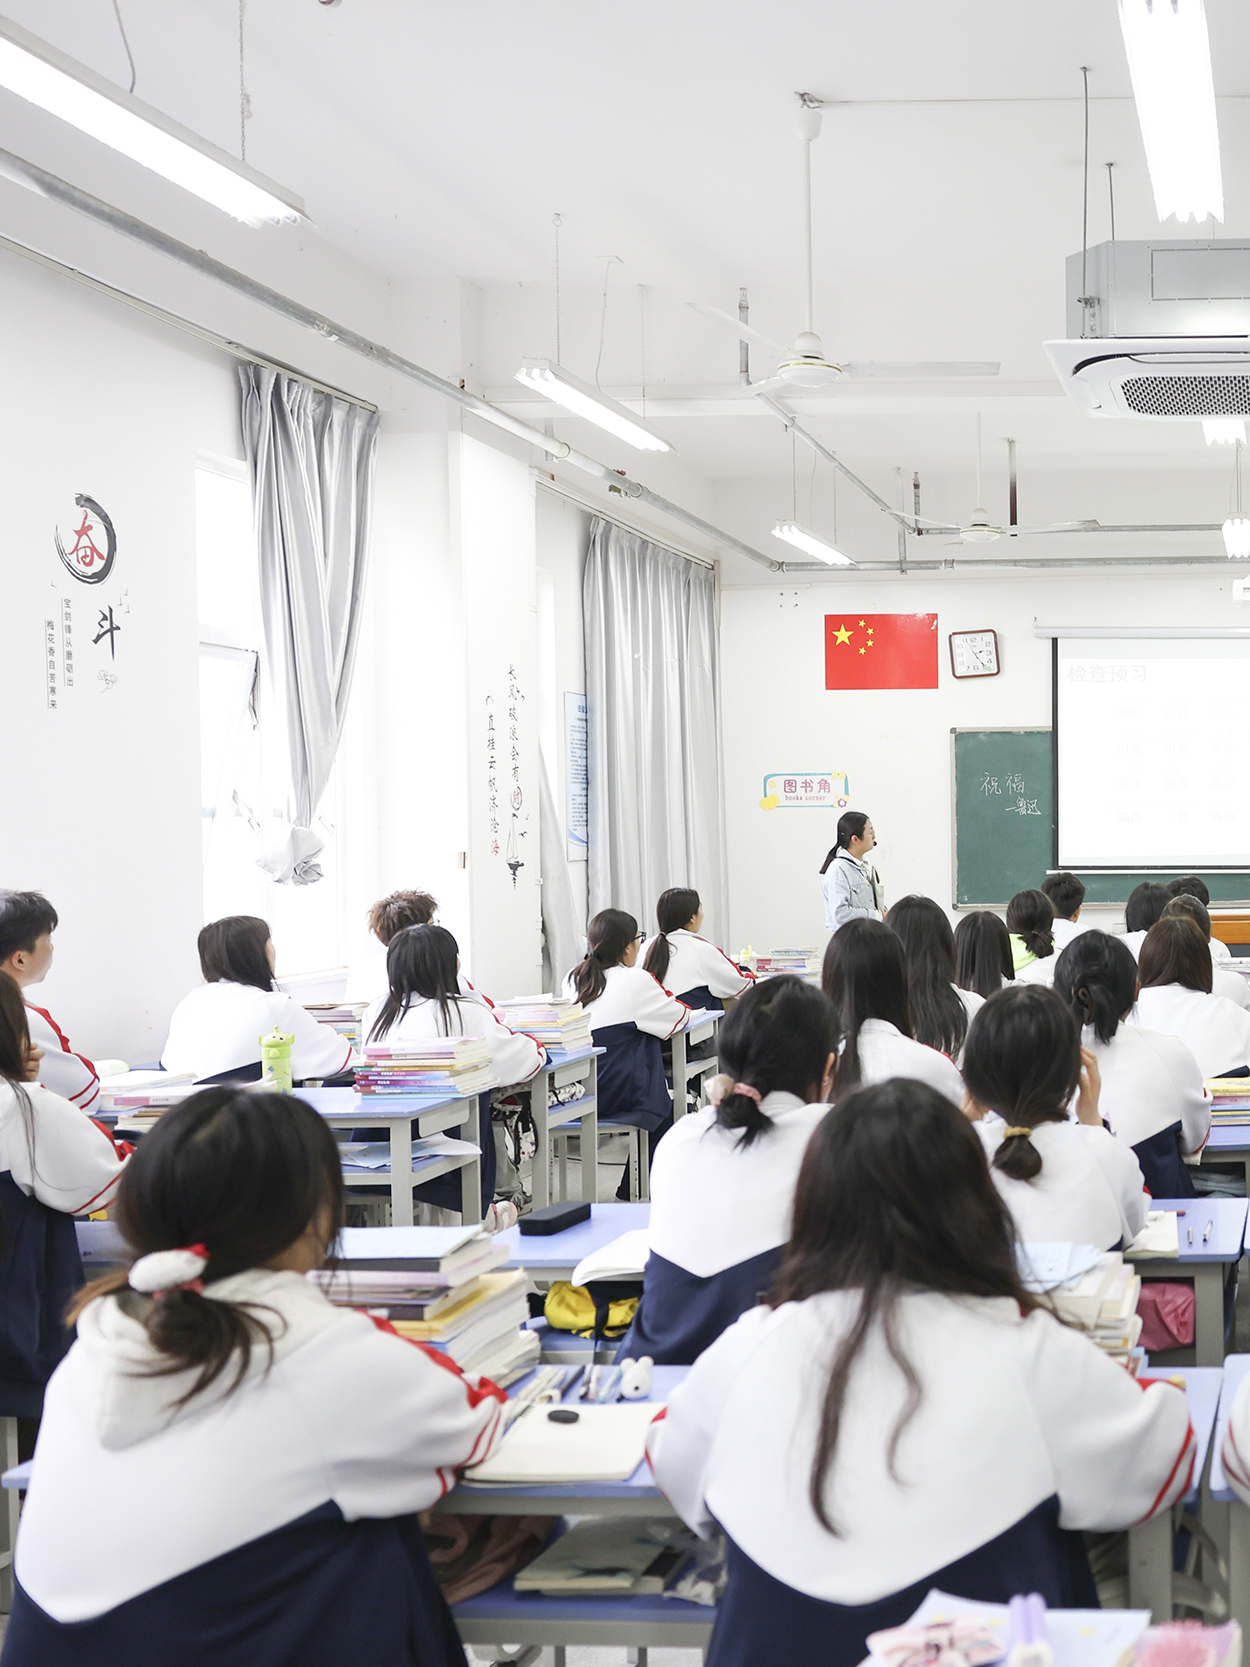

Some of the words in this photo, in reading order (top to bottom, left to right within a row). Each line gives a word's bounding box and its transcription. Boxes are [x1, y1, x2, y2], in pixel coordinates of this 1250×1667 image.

[91, 604, 121, 661] 斗
[1068, 664, 1147, 683] 检查预习
[783, 778, 831, 794] 图书角
[980, 771, 1025, 796] 祝福
